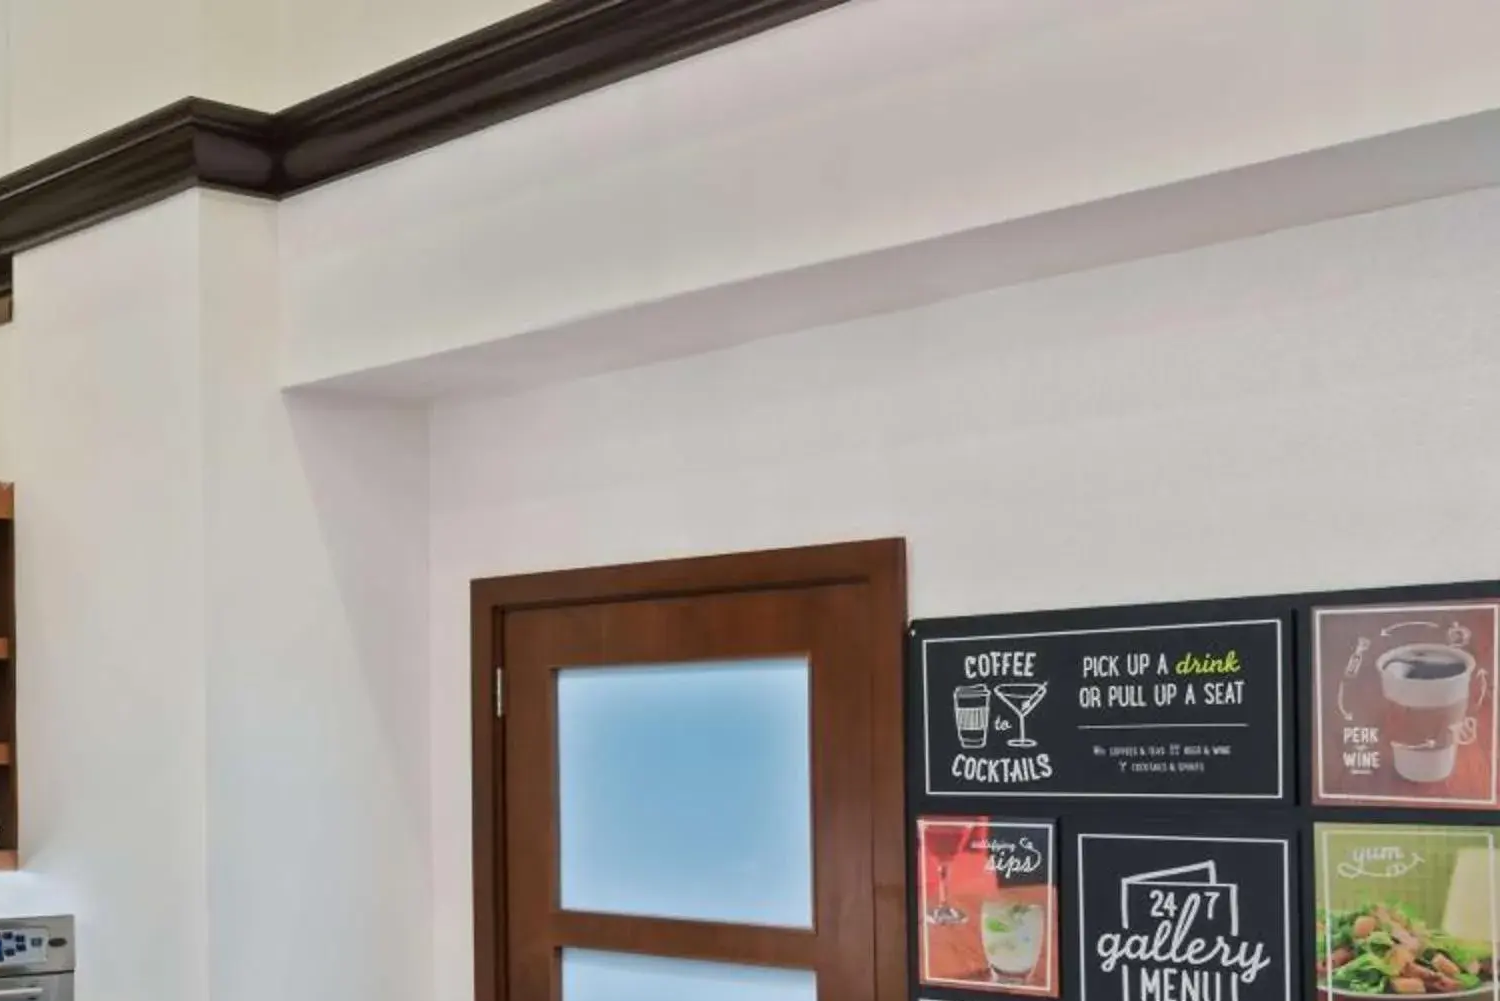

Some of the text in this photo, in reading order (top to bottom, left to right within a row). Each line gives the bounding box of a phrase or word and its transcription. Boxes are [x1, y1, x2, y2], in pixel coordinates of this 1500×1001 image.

[965, 651, 1037, 679] COFFEE
[1082, 650, 1241, 678] PICK UP A drink
[1079, 680, 1246, 708] OR PULL UP A SEAT
[994, 714, 1012, 731] to
[1343, 727, 1380, 744] PERK
[952, 753, 1052, 782] COCKTAILS
[1342, 751, 1381, 769] WINE
[985, 851, 1041, 880] sips
[1150, 890, 1177, 918] 24
[1097, 892, 1271, 983] gallery
